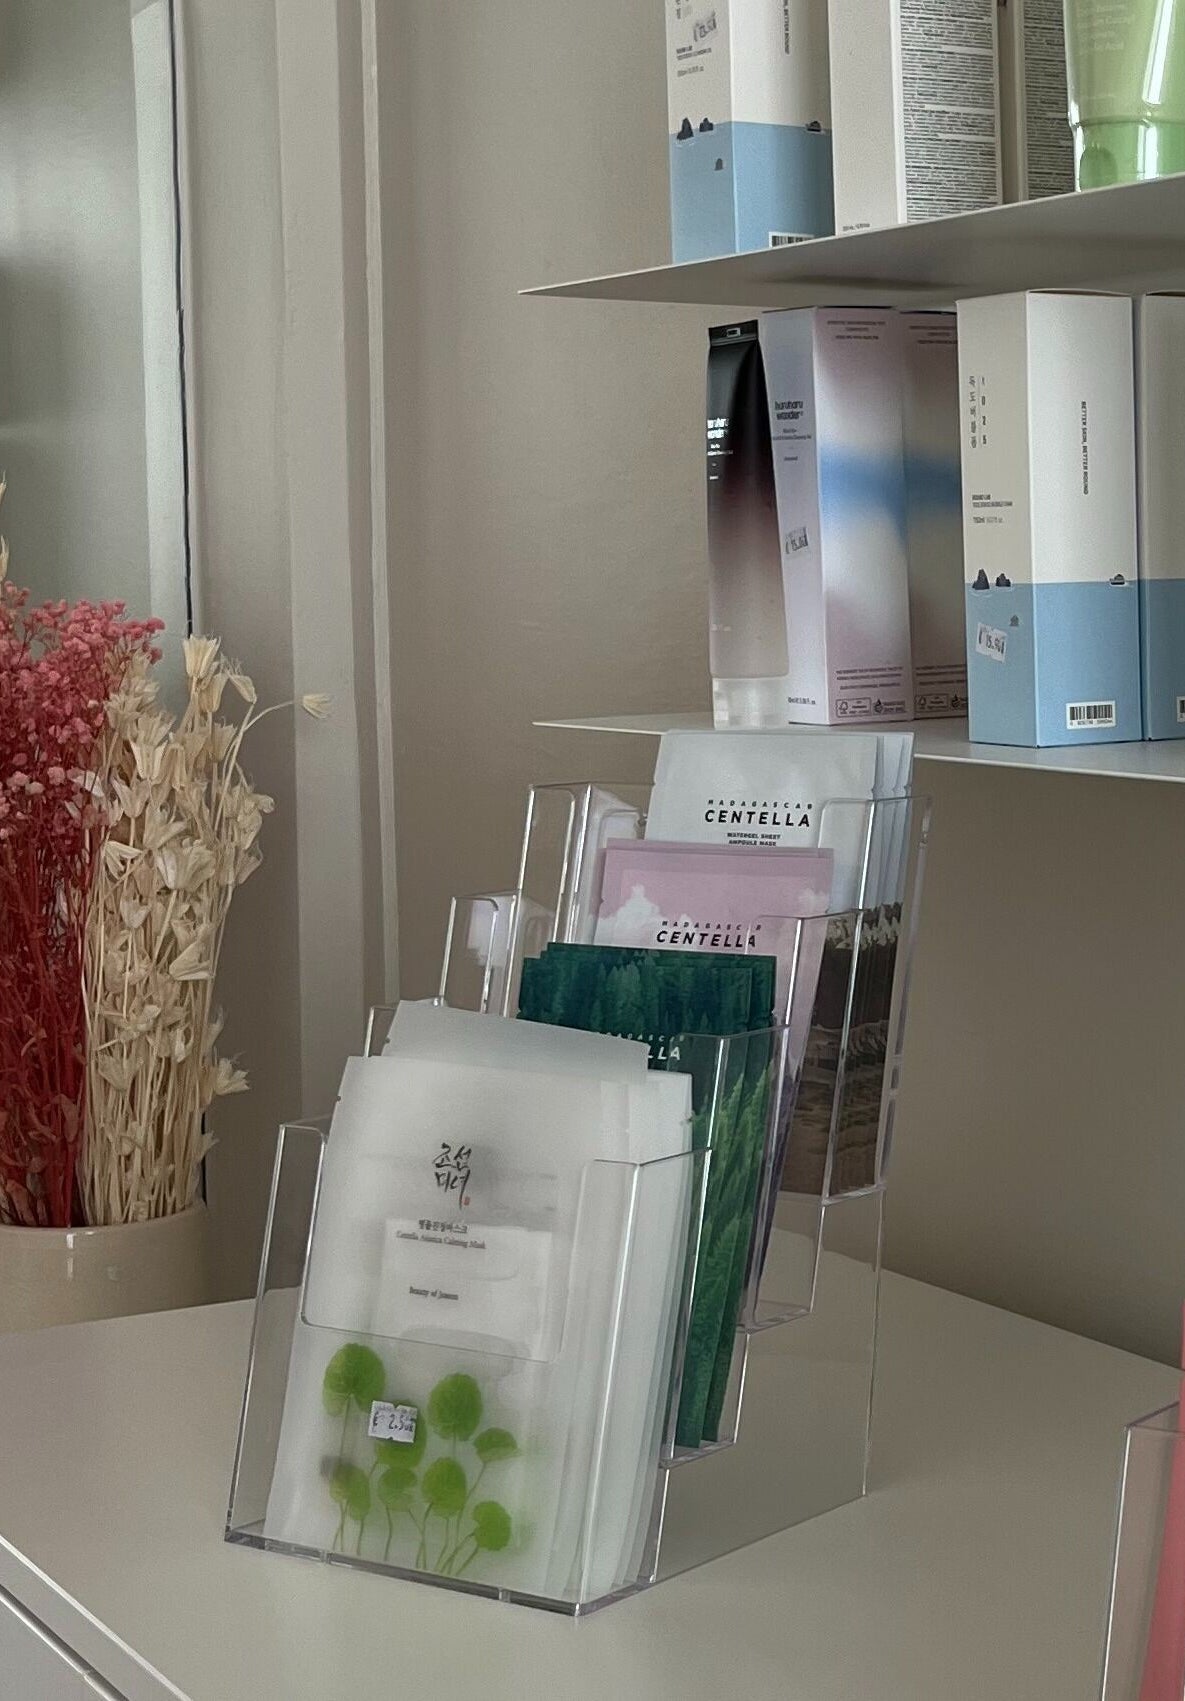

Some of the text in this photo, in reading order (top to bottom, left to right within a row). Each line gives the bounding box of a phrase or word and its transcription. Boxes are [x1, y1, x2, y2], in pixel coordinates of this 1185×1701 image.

[708, 799, 813, 810] MADAGASCAR
[704, 809, 810, 828] CENTELLA
[662, 920, 762, 931] MADAGASCR
[656, 930, 756, 948] CENTELLA
